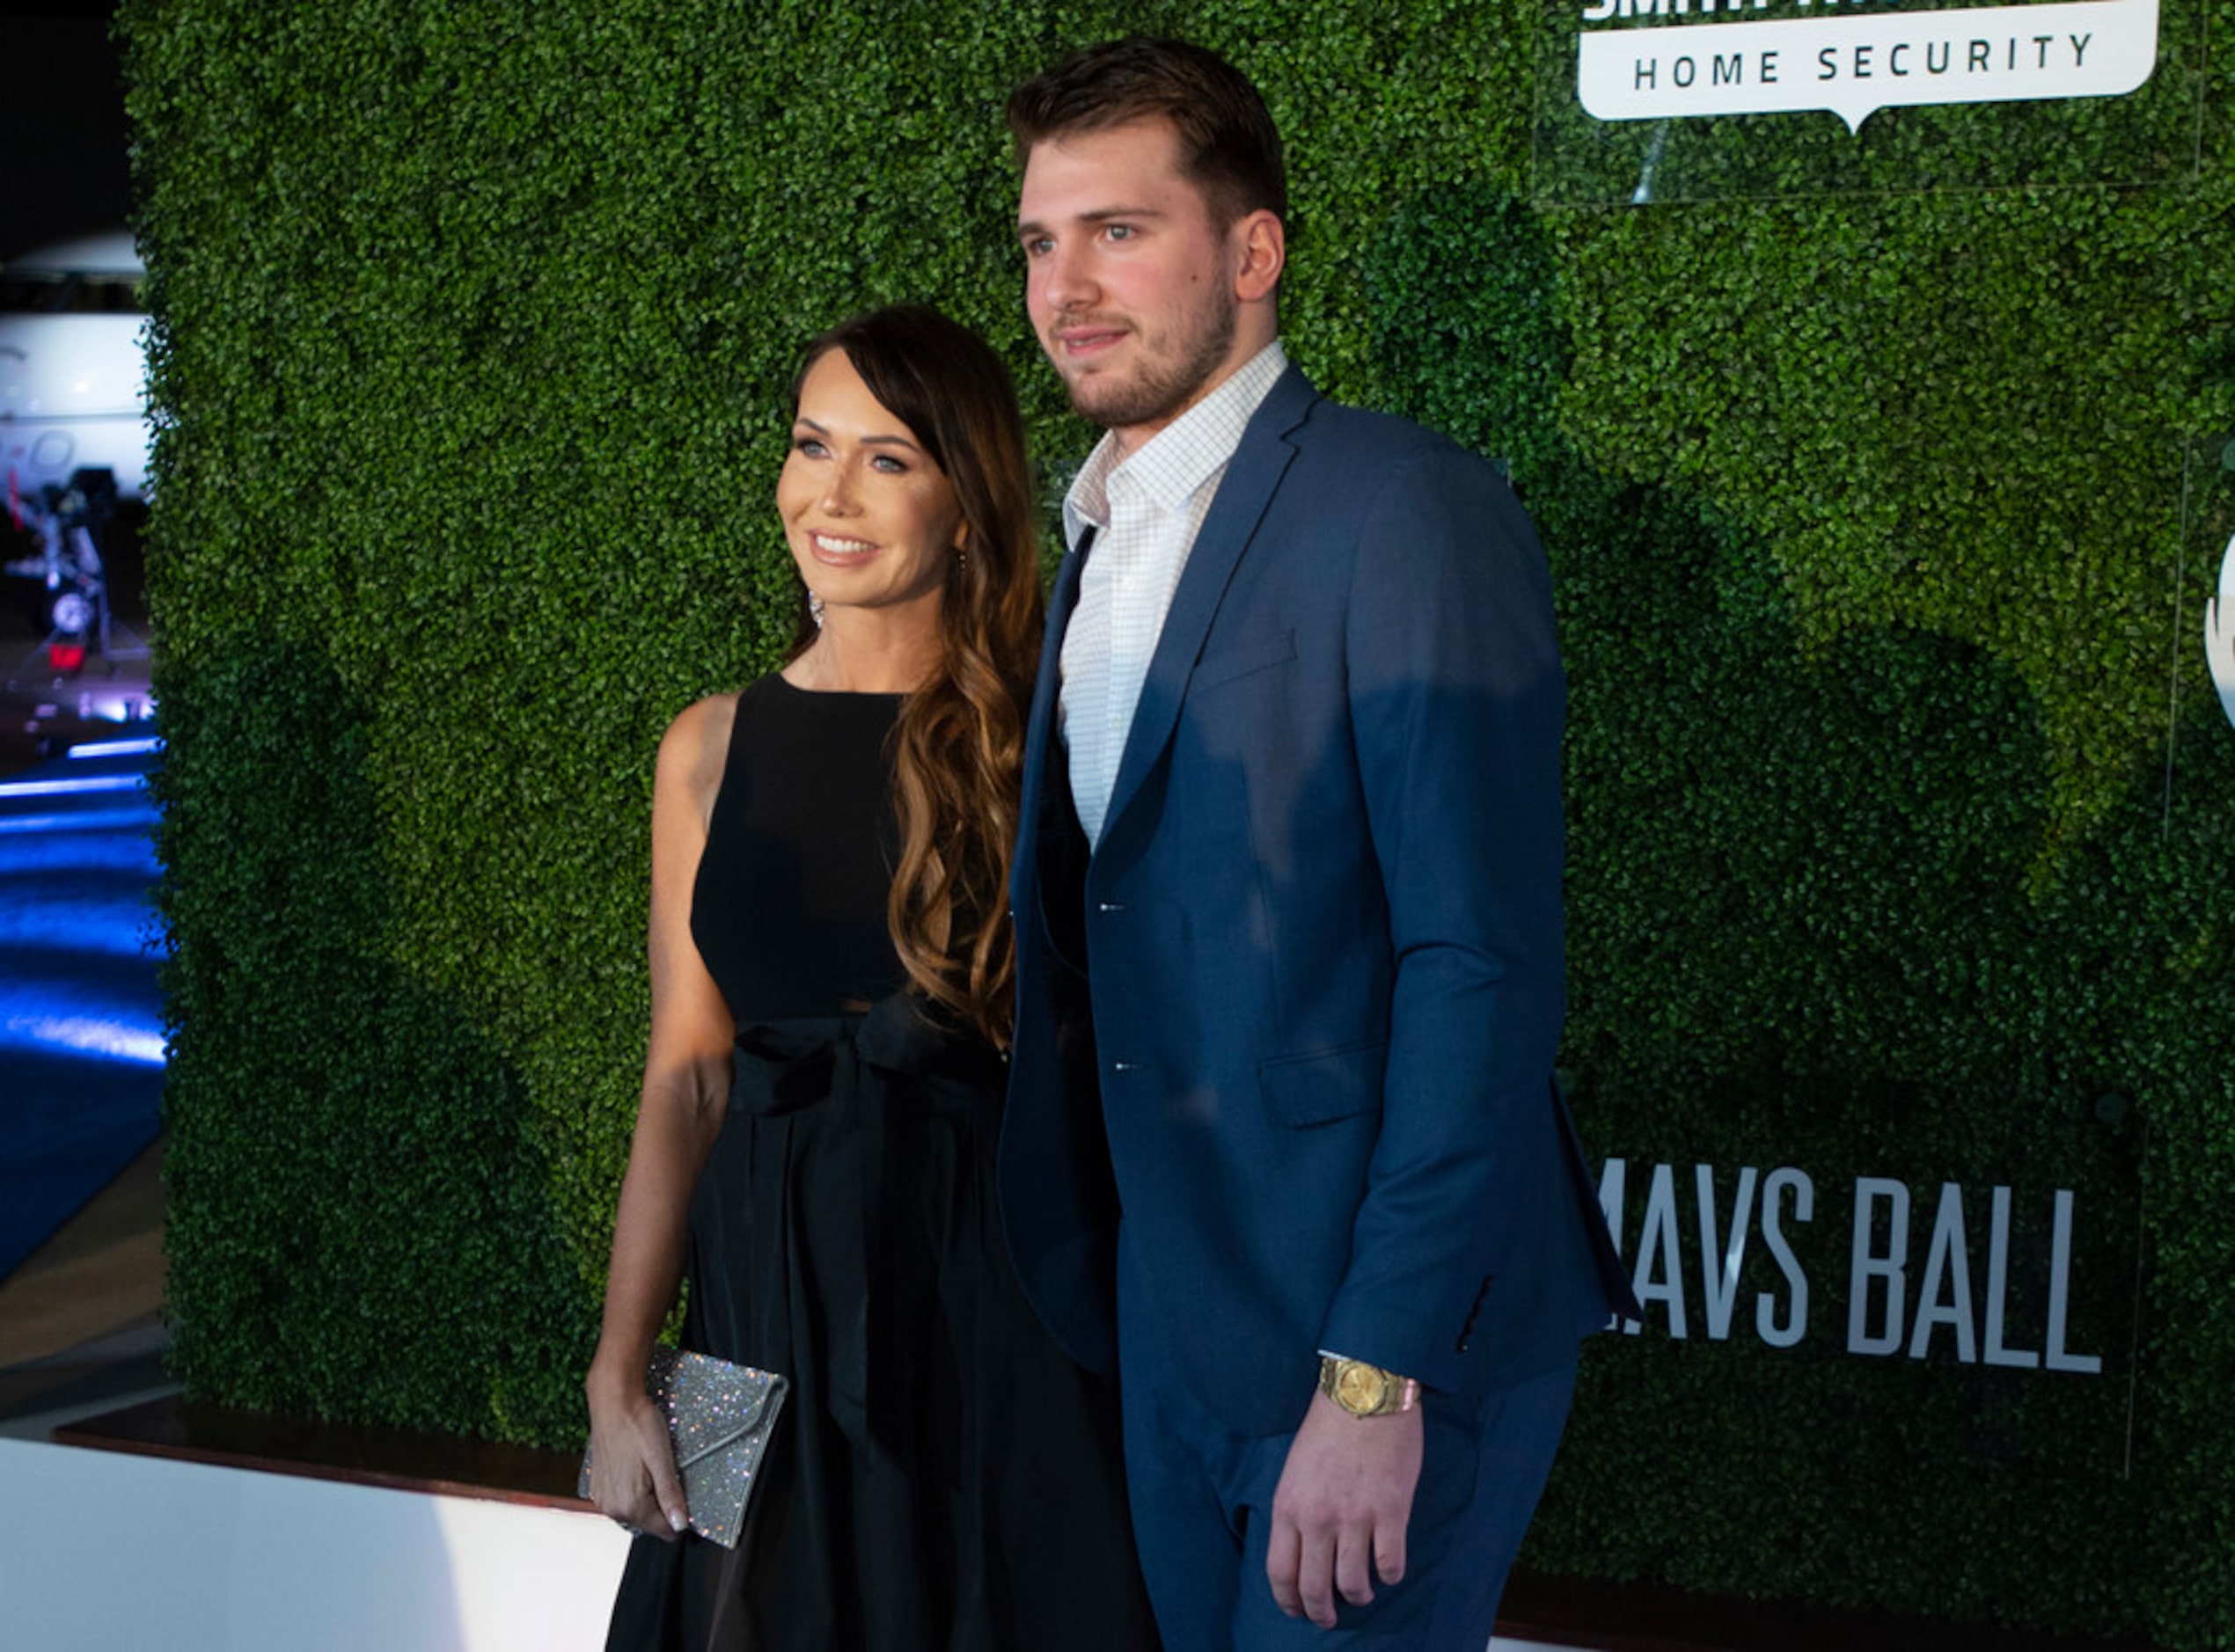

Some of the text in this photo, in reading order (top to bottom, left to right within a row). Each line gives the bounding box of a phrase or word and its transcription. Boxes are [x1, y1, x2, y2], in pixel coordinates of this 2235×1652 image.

[1635, 33, 2093, 90] HOME SECURITY
[1848, 1177, 2102, 1374] BALL
